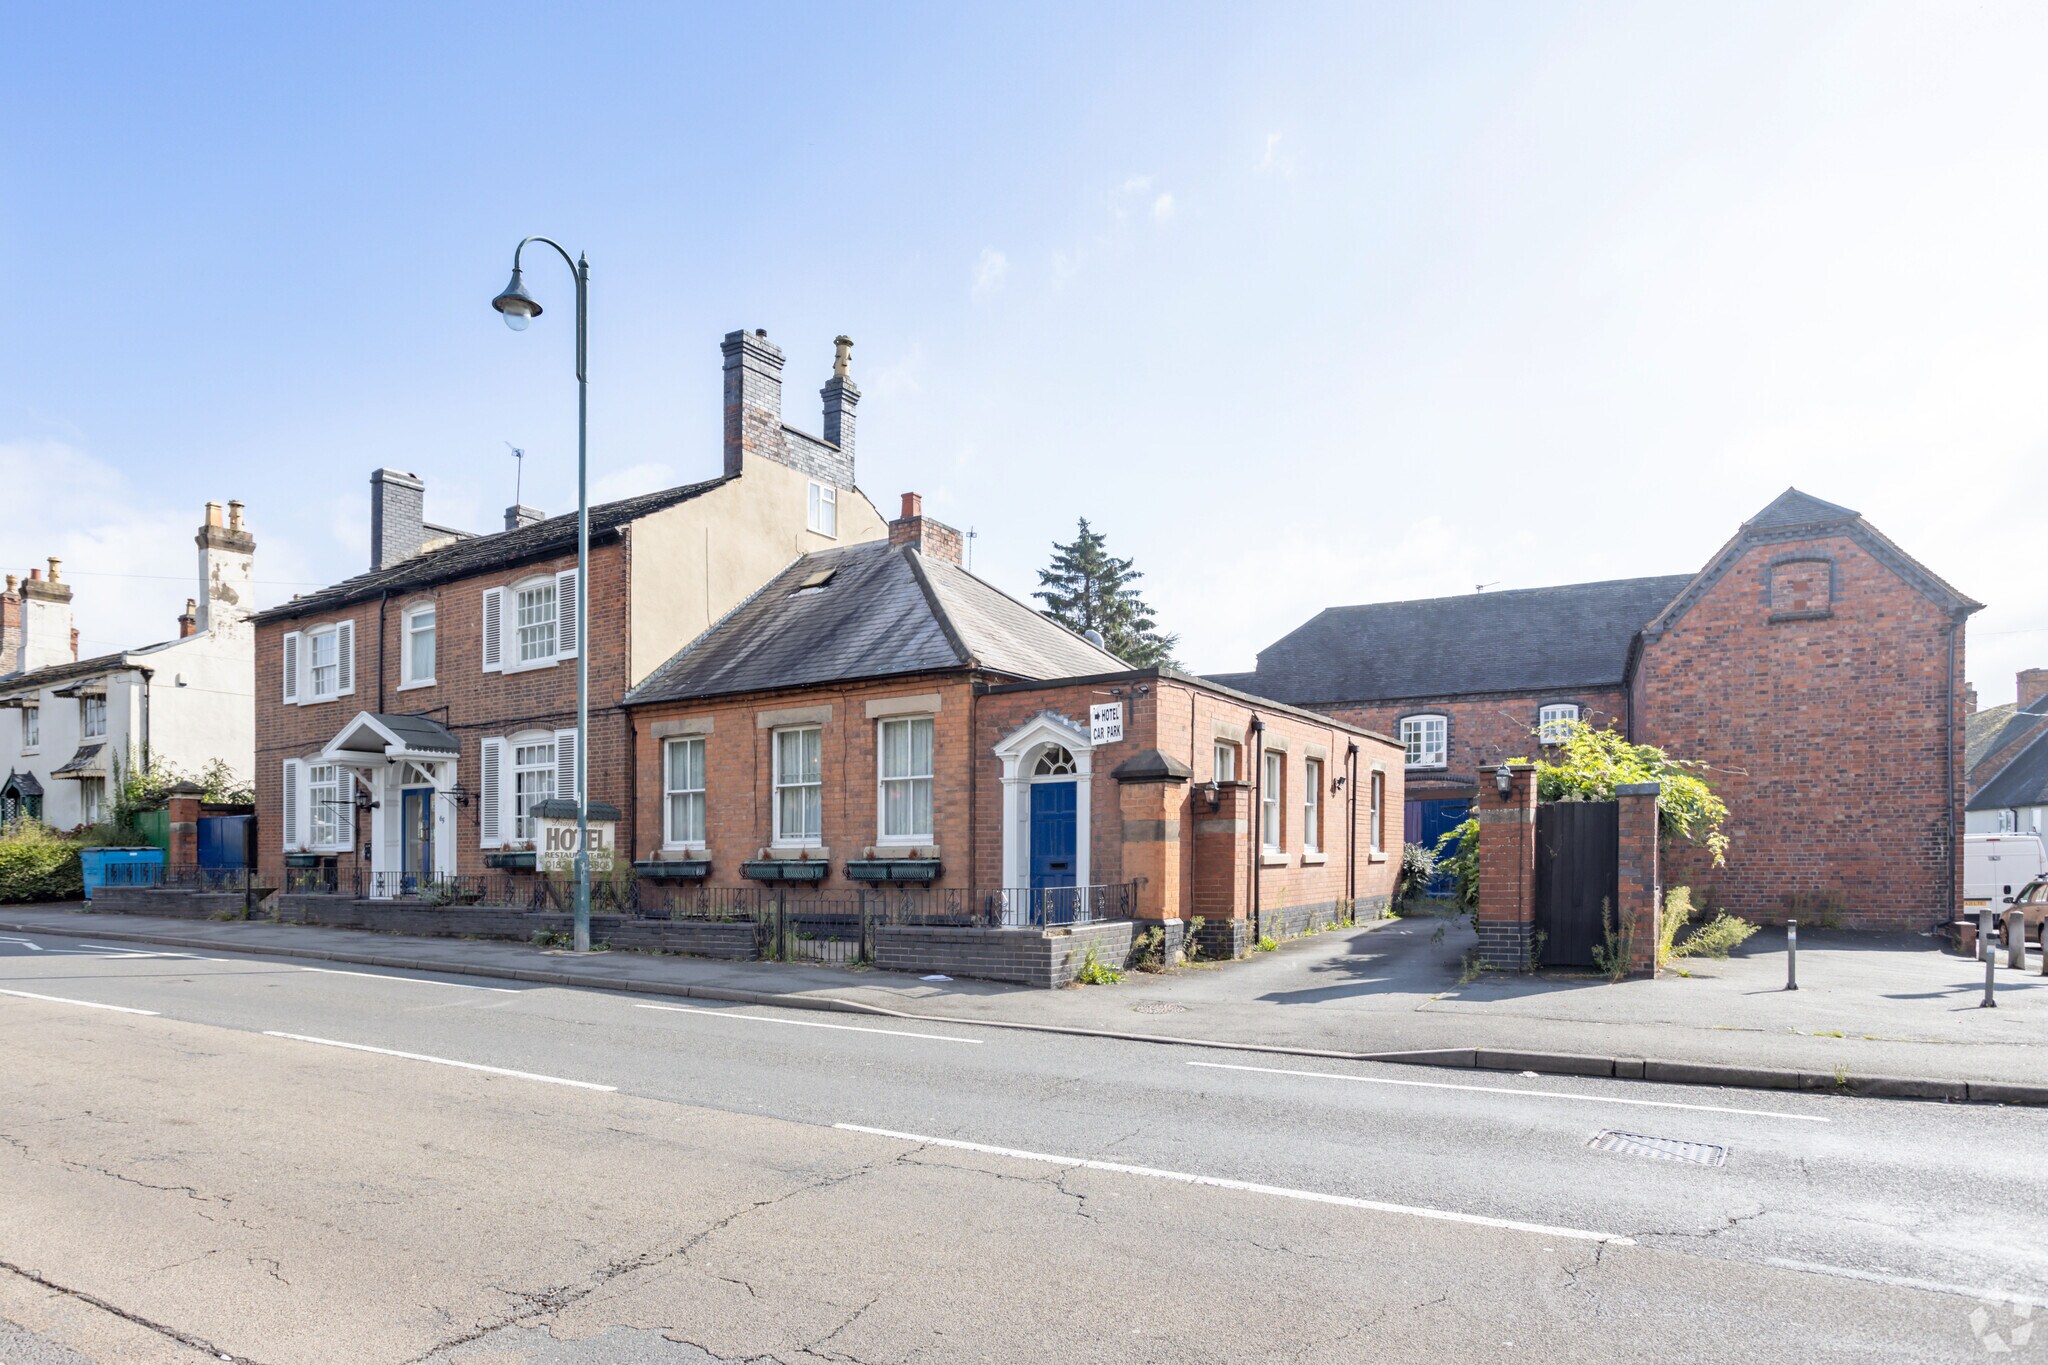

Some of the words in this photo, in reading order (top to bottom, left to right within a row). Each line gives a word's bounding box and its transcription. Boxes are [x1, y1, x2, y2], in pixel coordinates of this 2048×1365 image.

[1101, 708, 1119, 721] HOTEL
[1094, 727, 1104, 740] CAR
[1107, 725, 1121, 738] PARK
